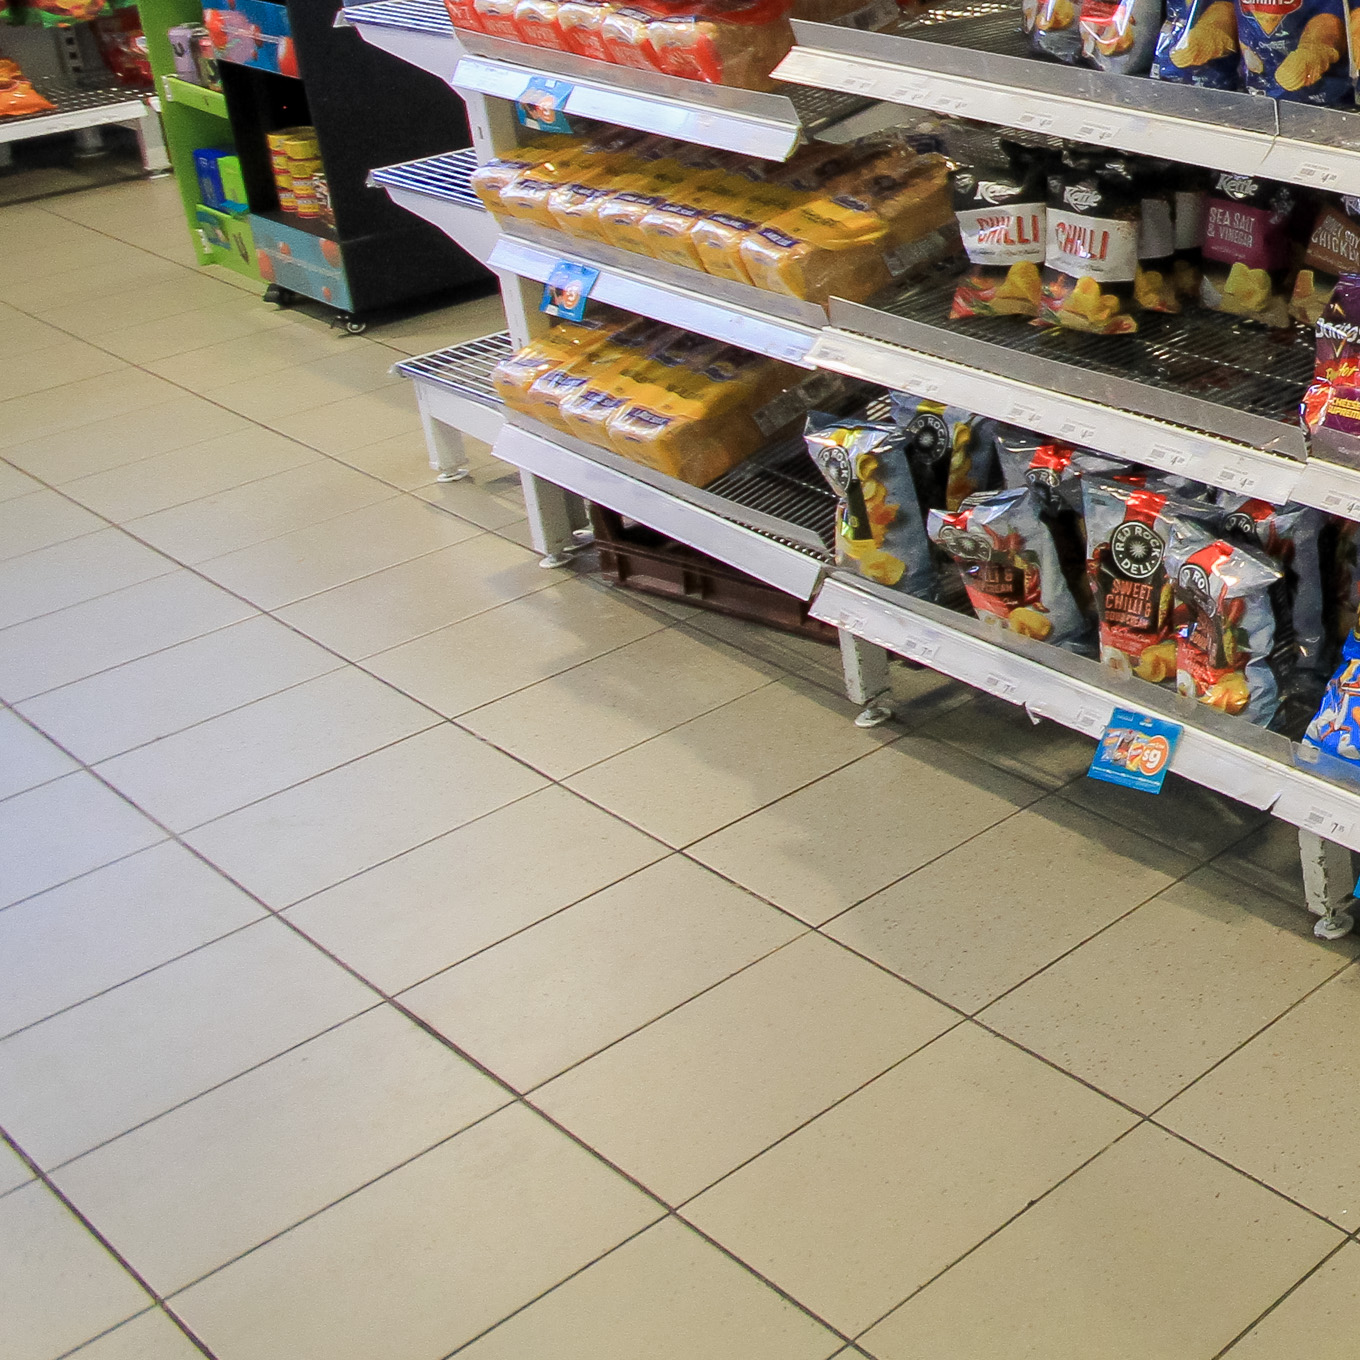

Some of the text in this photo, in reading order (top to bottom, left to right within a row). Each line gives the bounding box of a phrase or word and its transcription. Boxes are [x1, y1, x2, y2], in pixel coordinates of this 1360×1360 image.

[1214, 173, 1259, 199] Kettle
[1209, 208, 1255, 233] SEA SALT
[1115, 526, 1160, 557] RED ROCK
[1121, 558, 1151, 574] DELI
[1112, 578, 1153, 600] SWEET
[1142, 744, 1161, 770] $9
